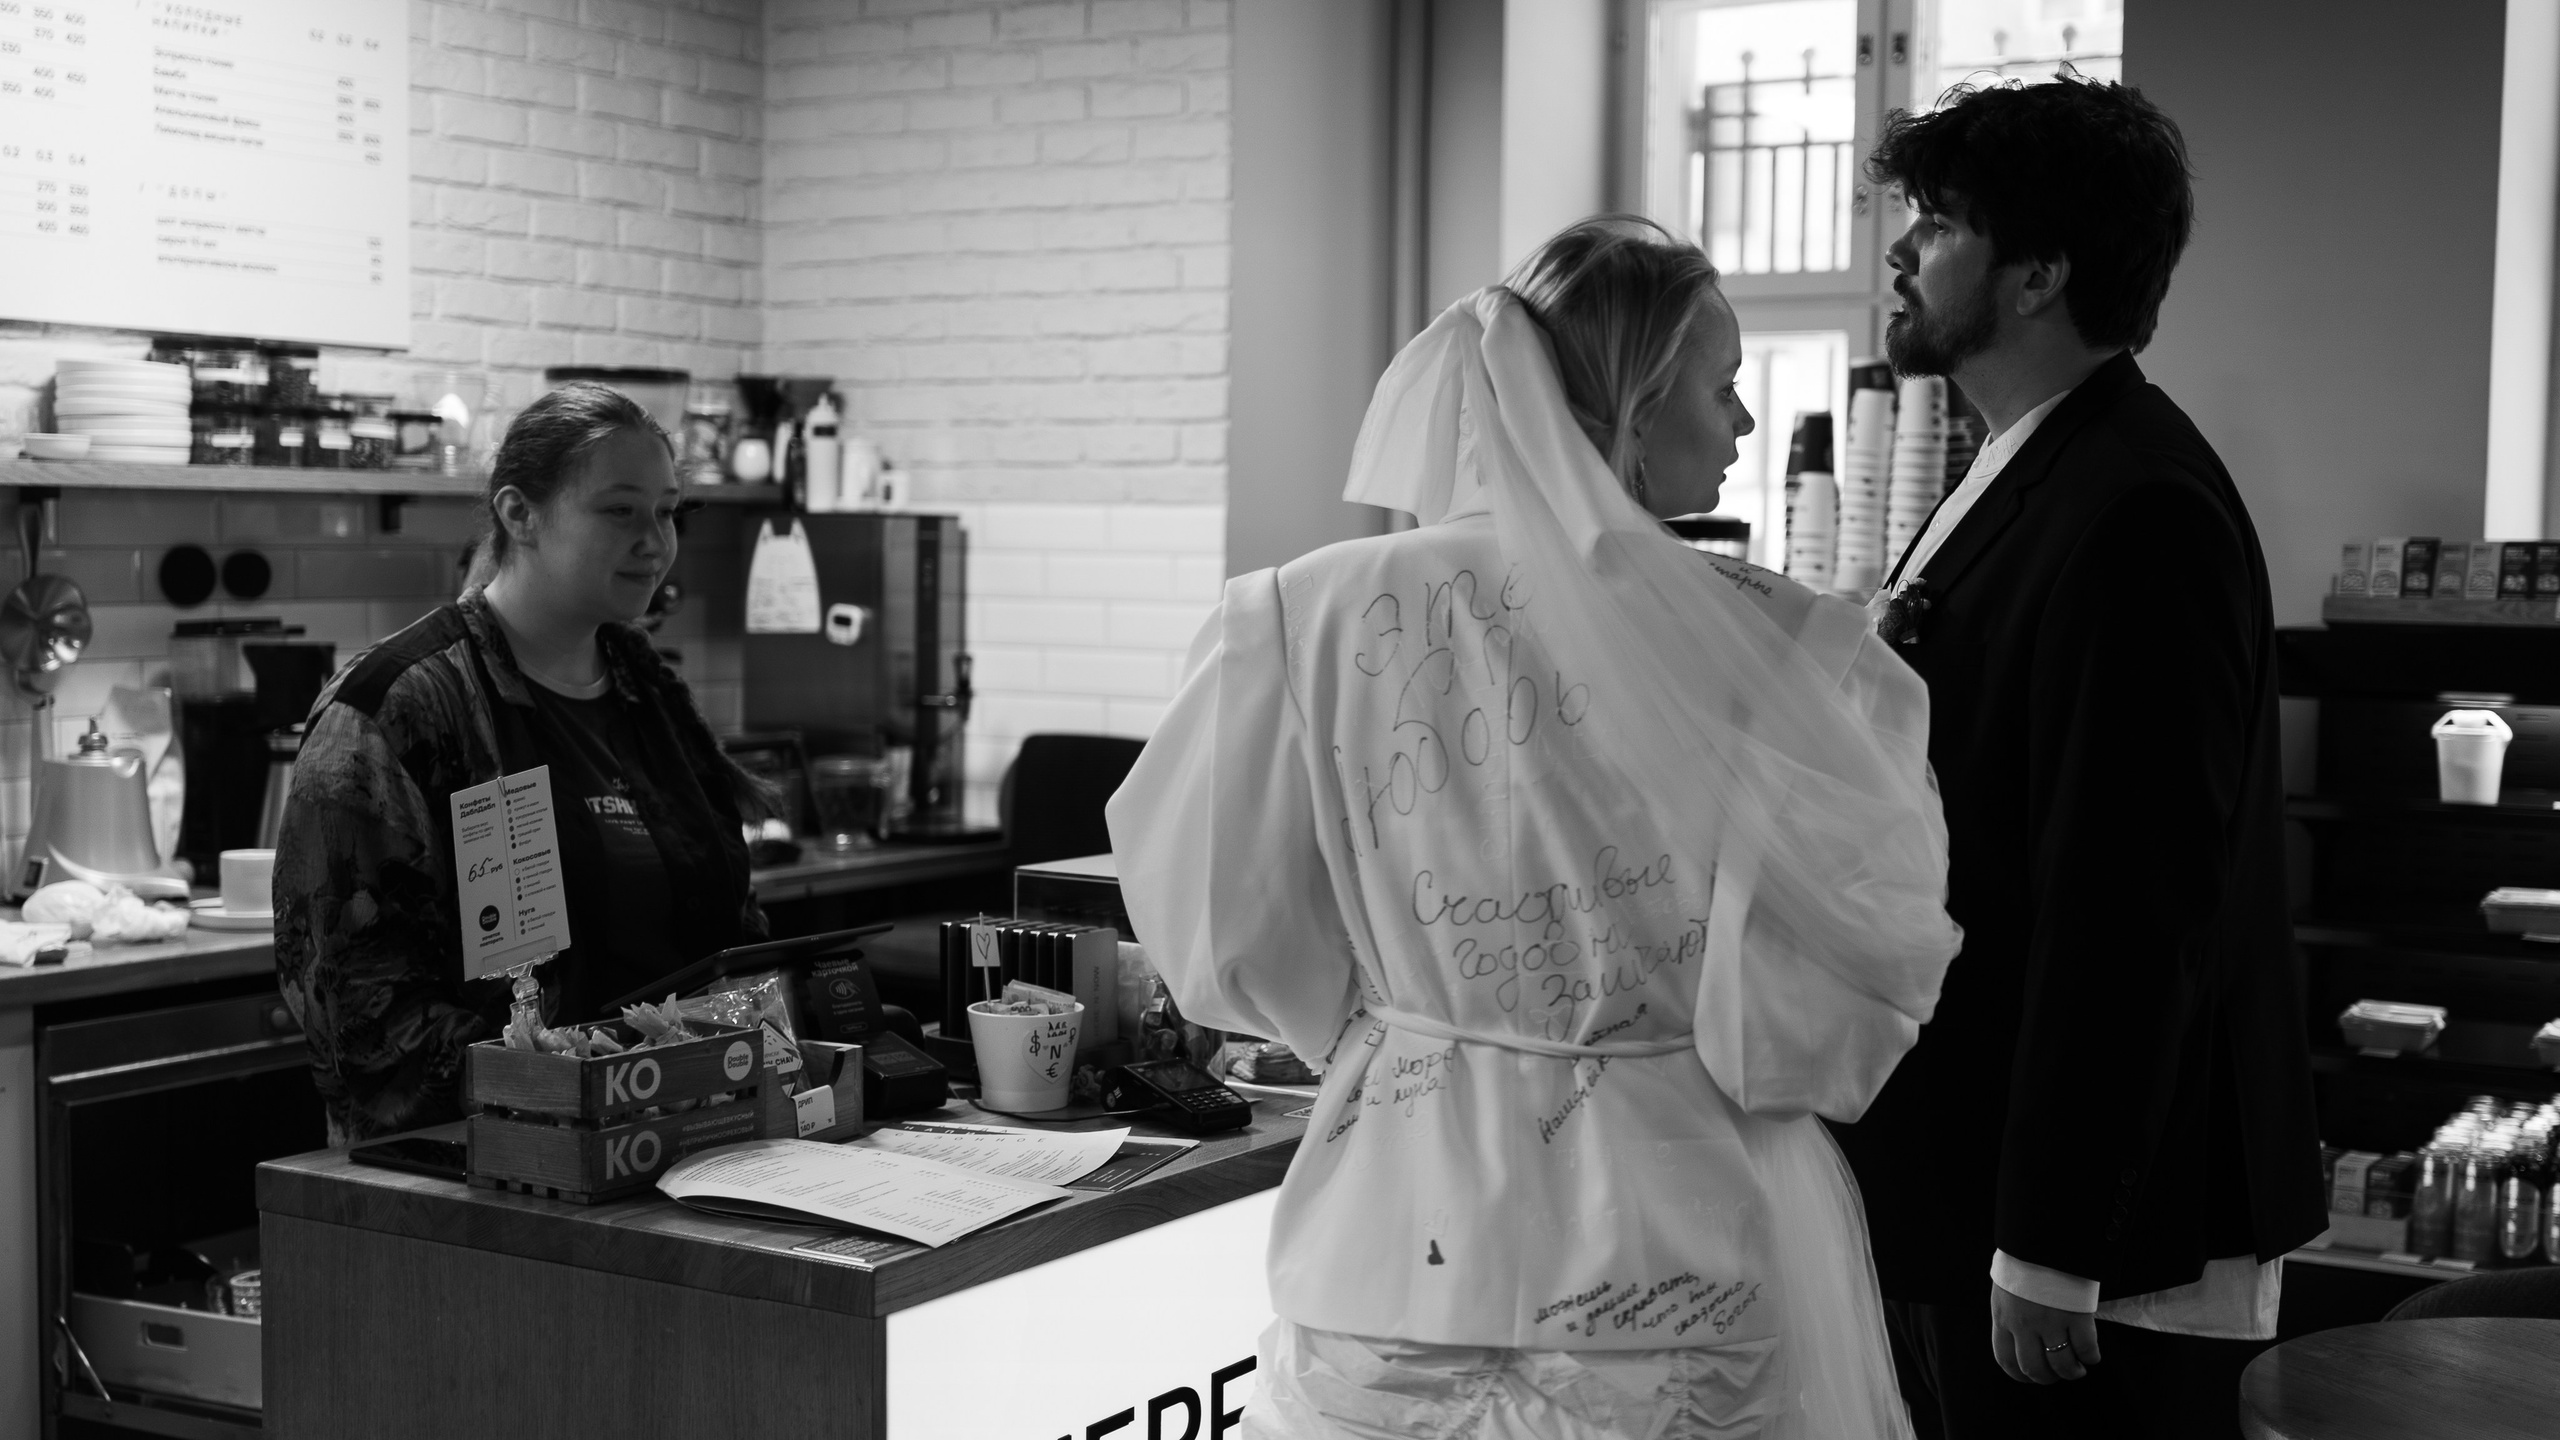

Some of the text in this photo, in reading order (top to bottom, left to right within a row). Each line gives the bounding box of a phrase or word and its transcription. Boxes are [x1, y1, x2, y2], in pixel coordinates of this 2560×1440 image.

[460, 796, 491, 810] Конфеты
[460, 803, 496, 819] ДаблДабл
[513, 849, 551, 865] Кокосовые
[468, 857, 504, 883] 65 руб
[518, 907, 535, 917] Нуга
[811, 962, 859, 978] карточкой
[727, 1053, 749, 1063] Double
[727, 1060, 749, 1069] Double
[798, 1097, 813, 1109] ДРИП
